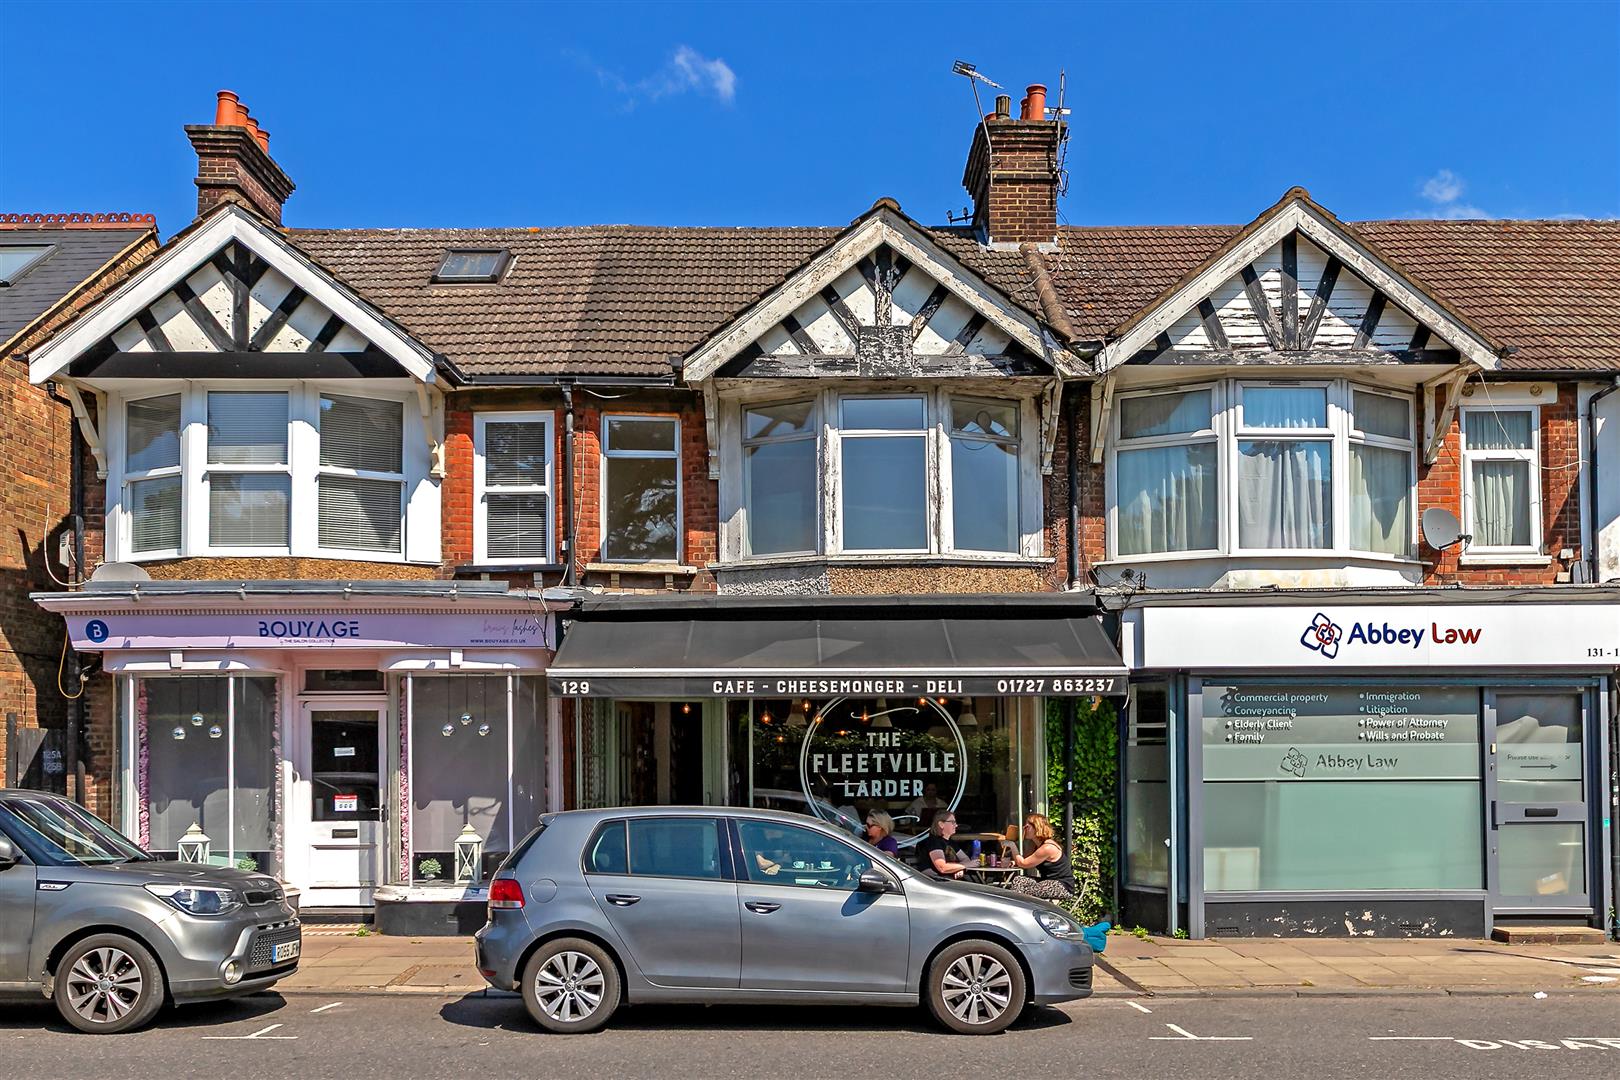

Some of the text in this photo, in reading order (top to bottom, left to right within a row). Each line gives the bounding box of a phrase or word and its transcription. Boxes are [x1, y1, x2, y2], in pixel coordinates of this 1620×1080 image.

[258, 620, 360, 638] BOUYAGE
[1347, 622, 1482, 649] Abbey Law
[1587, 648, 1603, 657] 131
[561, 681, 590, 694] 129
[712, 680, 755, 693] CAFE
[776, 680, 905, 693] CHEESEMONGER
[926, 680, 963, 693] DELI
[997, 678, 1115, 693] 01727 863237
[1234, 693, 1328, 703] Commercial property
[1366, 691, 1421, 703] Immigration
[1234, 705, 1296, 717] Conveyancing
[1366, 705, 1408, 716] Litigation
[1234, 719, 1293, 731] Elderly Client
[1366, 717, 1448, 728] Power of Attorney
[867, 732, 901, 747] THE
[1234, 732, 1264, 742] Family
[1366, 731, 1445, 740] Wills and Probate
[813, 753, 956, 773] FLEETVILLE
[1316, 754, 1398, 770] Abbey Law
[844, 779, 924, 797] LARDER
